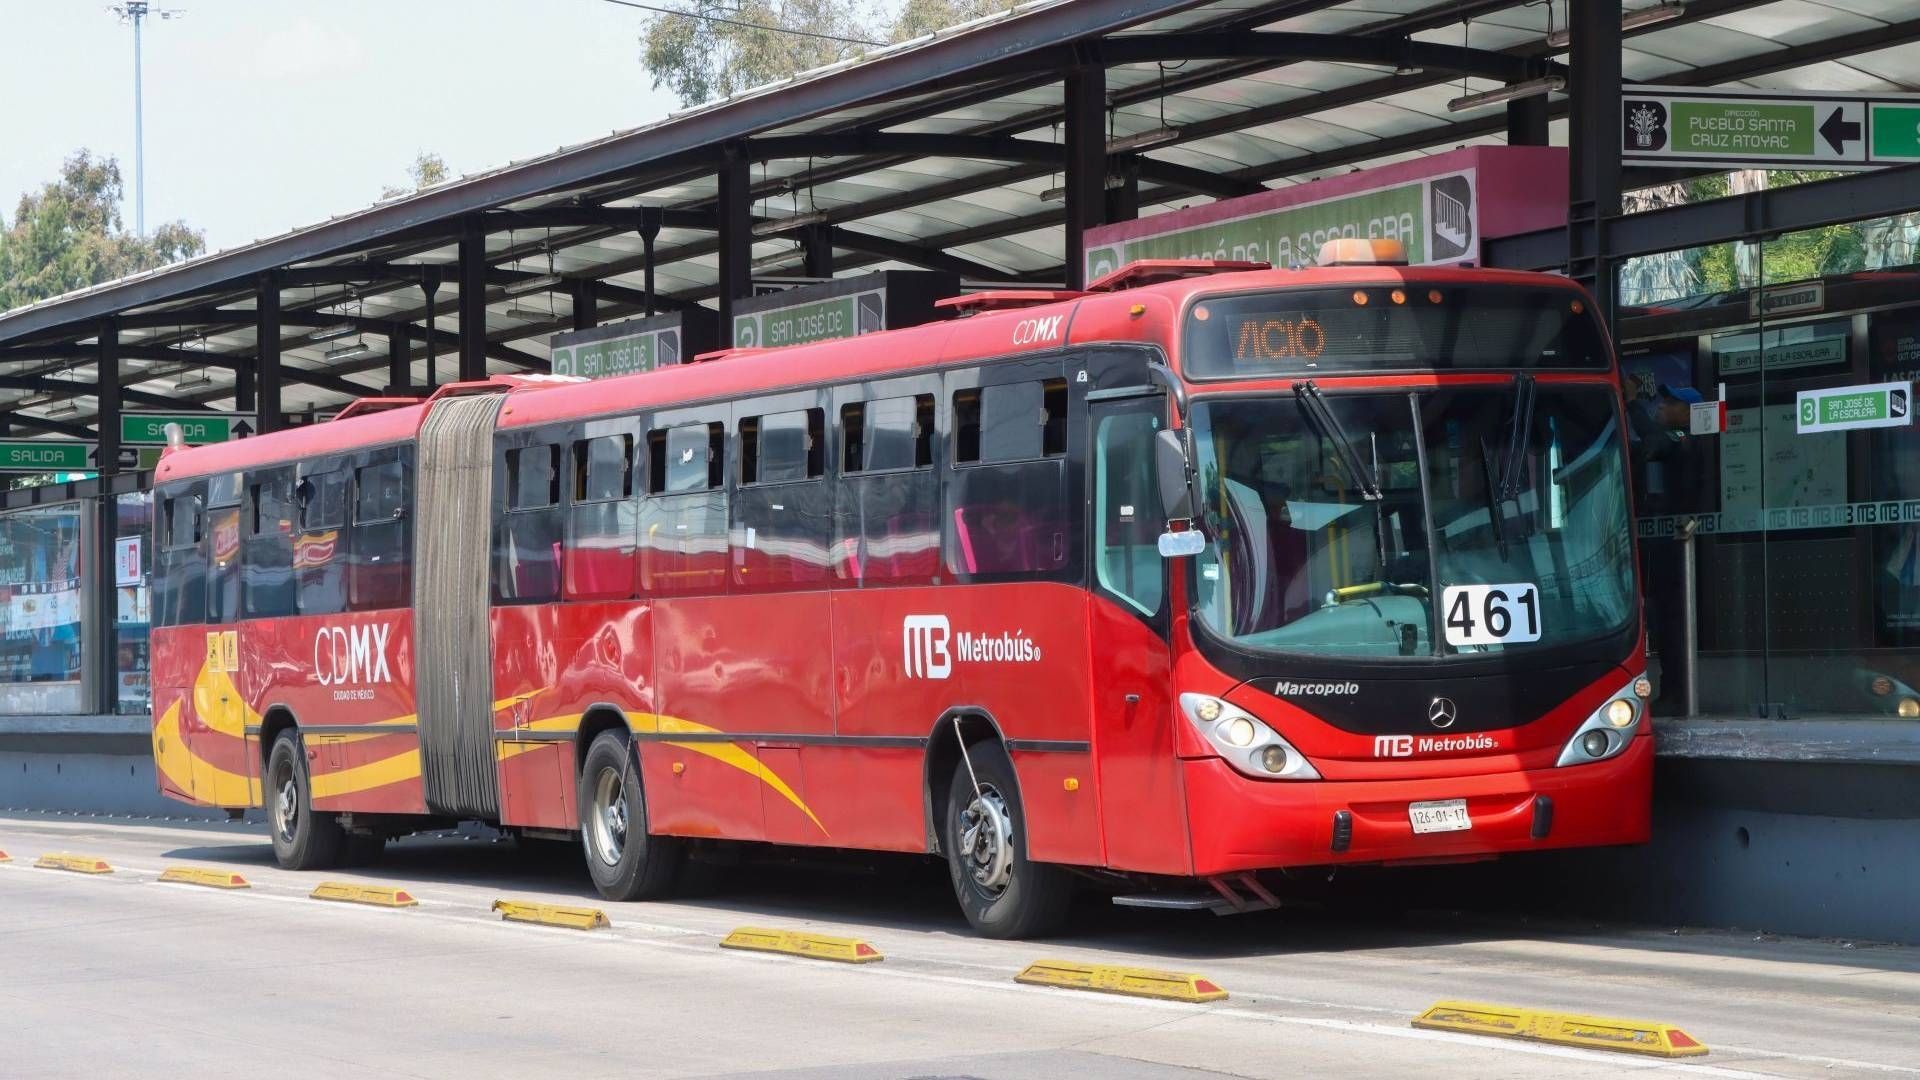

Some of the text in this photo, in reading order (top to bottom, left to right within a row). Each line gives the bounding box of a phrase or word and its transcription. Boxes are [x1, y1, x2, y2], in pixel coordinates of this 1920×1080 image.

[1689, 116, 1796, 132] PUEBLO SANTA
[1691, 133, 1789, 149] CRUZ ATOYAC
[767, 319, 793, 343] SAN
[796, 306, 825, 337] JOSÉ
[827, 311, 843, 332] DE
[1013, 316, 1063, 345] CDMX
[584, 352, 603, 374] SAN
[606, 342, 630, 370] JOSÉ
[633, 345, 647, 366] DE
[1803, 402, 1813, 421] 3
[1829, 400, 1843, 410] SAN
[1864, 397, 1875, 407] DE
[1829, 407, 1877, 420] LA ESCALERA
[147, 423, 206, 437] SADA
[10, 450, 65, 462] SALIDA
[1447, 589, 1537, 637] 461
[315, 623, 391, 685] CDMX
[903, 614, 951, 679] MB
[1274, 682, 1359, 696] Marcopolo
[1374, 734, 1413, 757] MB
[1413, 808, 1466, 824] 126-01-17
